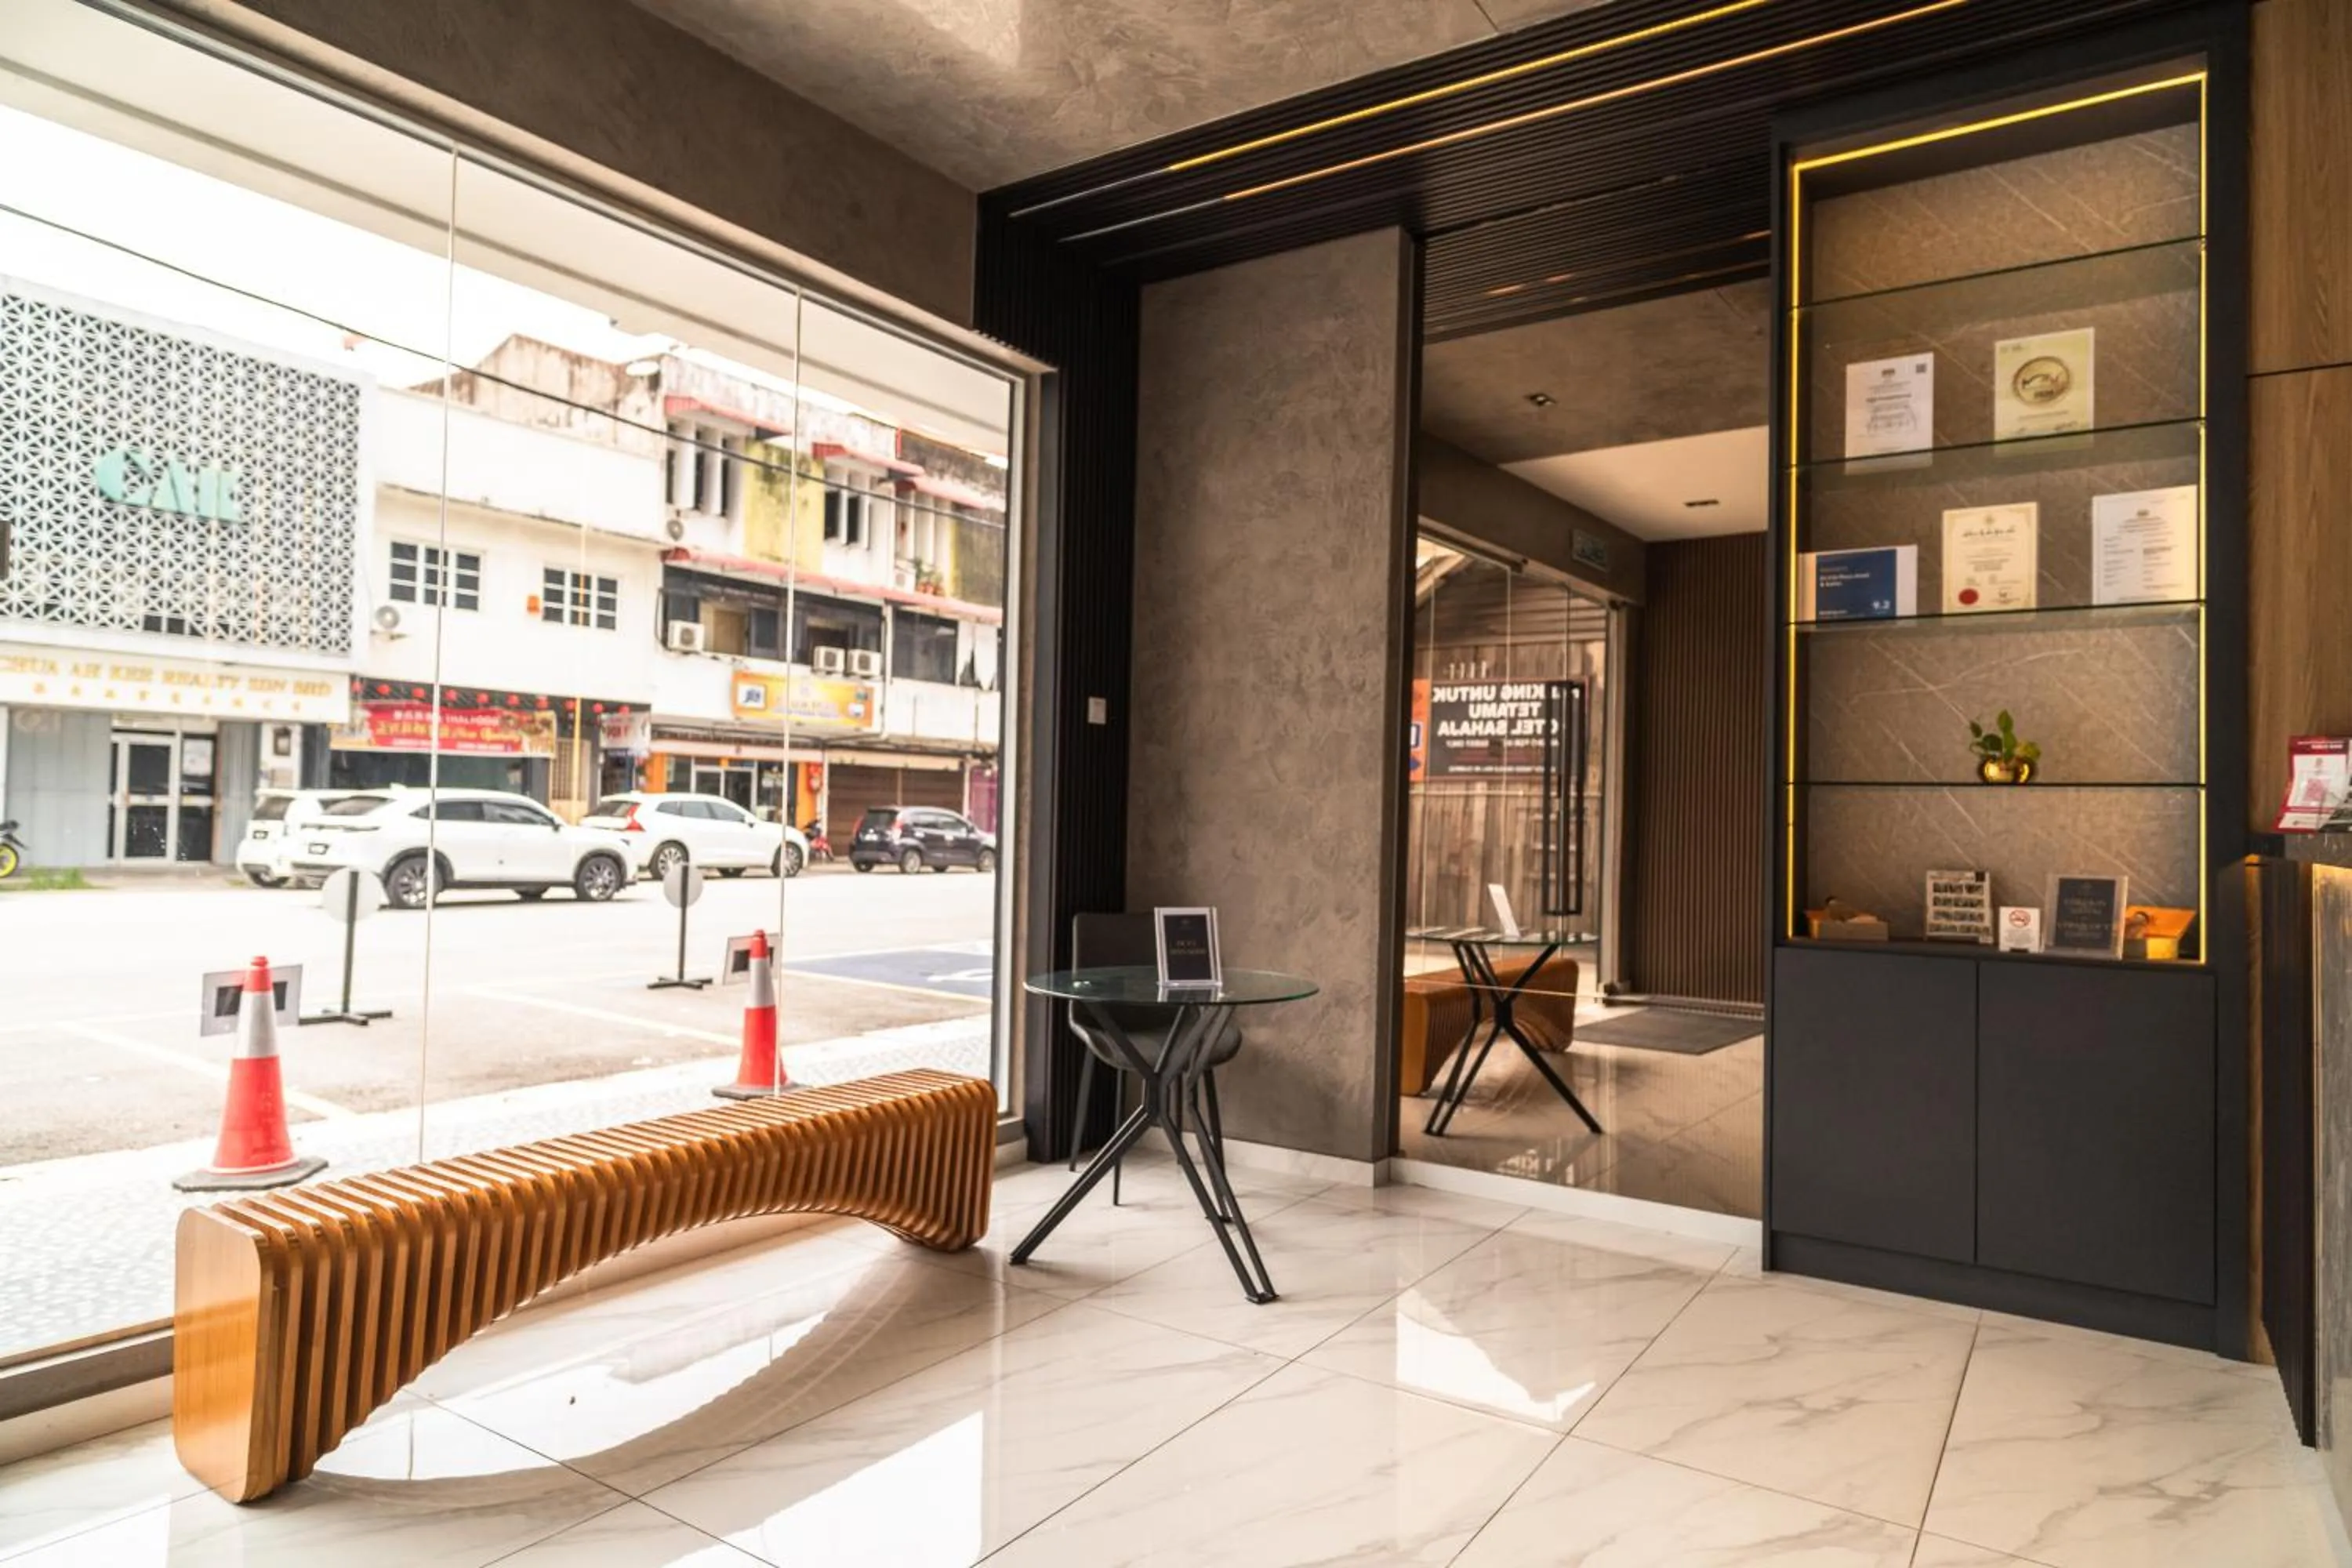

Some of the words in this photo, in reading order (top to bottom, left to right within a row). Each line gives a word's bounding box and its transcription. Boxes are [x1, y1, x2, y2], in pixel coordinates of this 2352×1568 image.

[162, 670, 240, 690] REALTY
[249, 677, 287, 693] SDN
[293, 680, 332, 696] BHD
